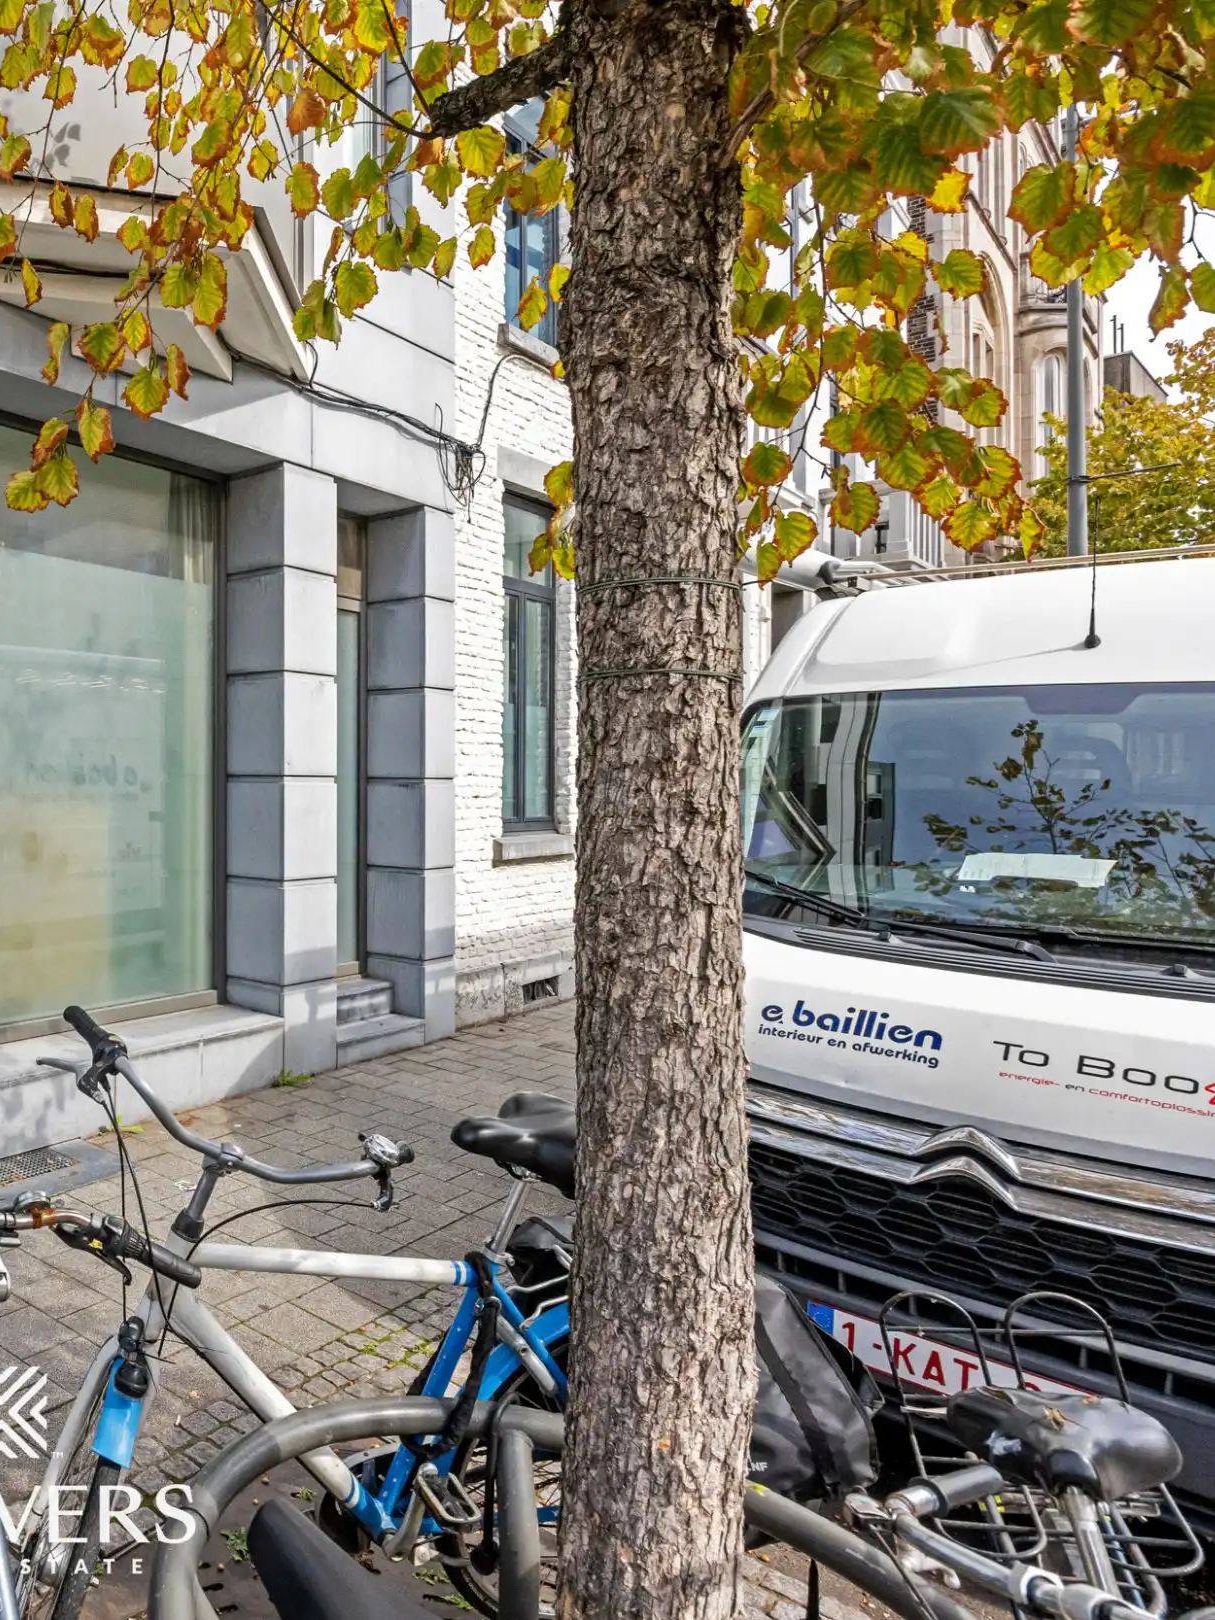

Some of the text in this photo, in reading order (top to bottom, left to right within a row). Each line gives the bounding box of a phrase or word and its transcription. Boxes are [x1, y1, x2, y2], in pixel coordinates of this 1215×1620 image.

[758, 1023, 940, 1070] interieur en afwerking
[792, 999, 943, 1051] baillien
[1065, 1083, 1085, 1093] en
